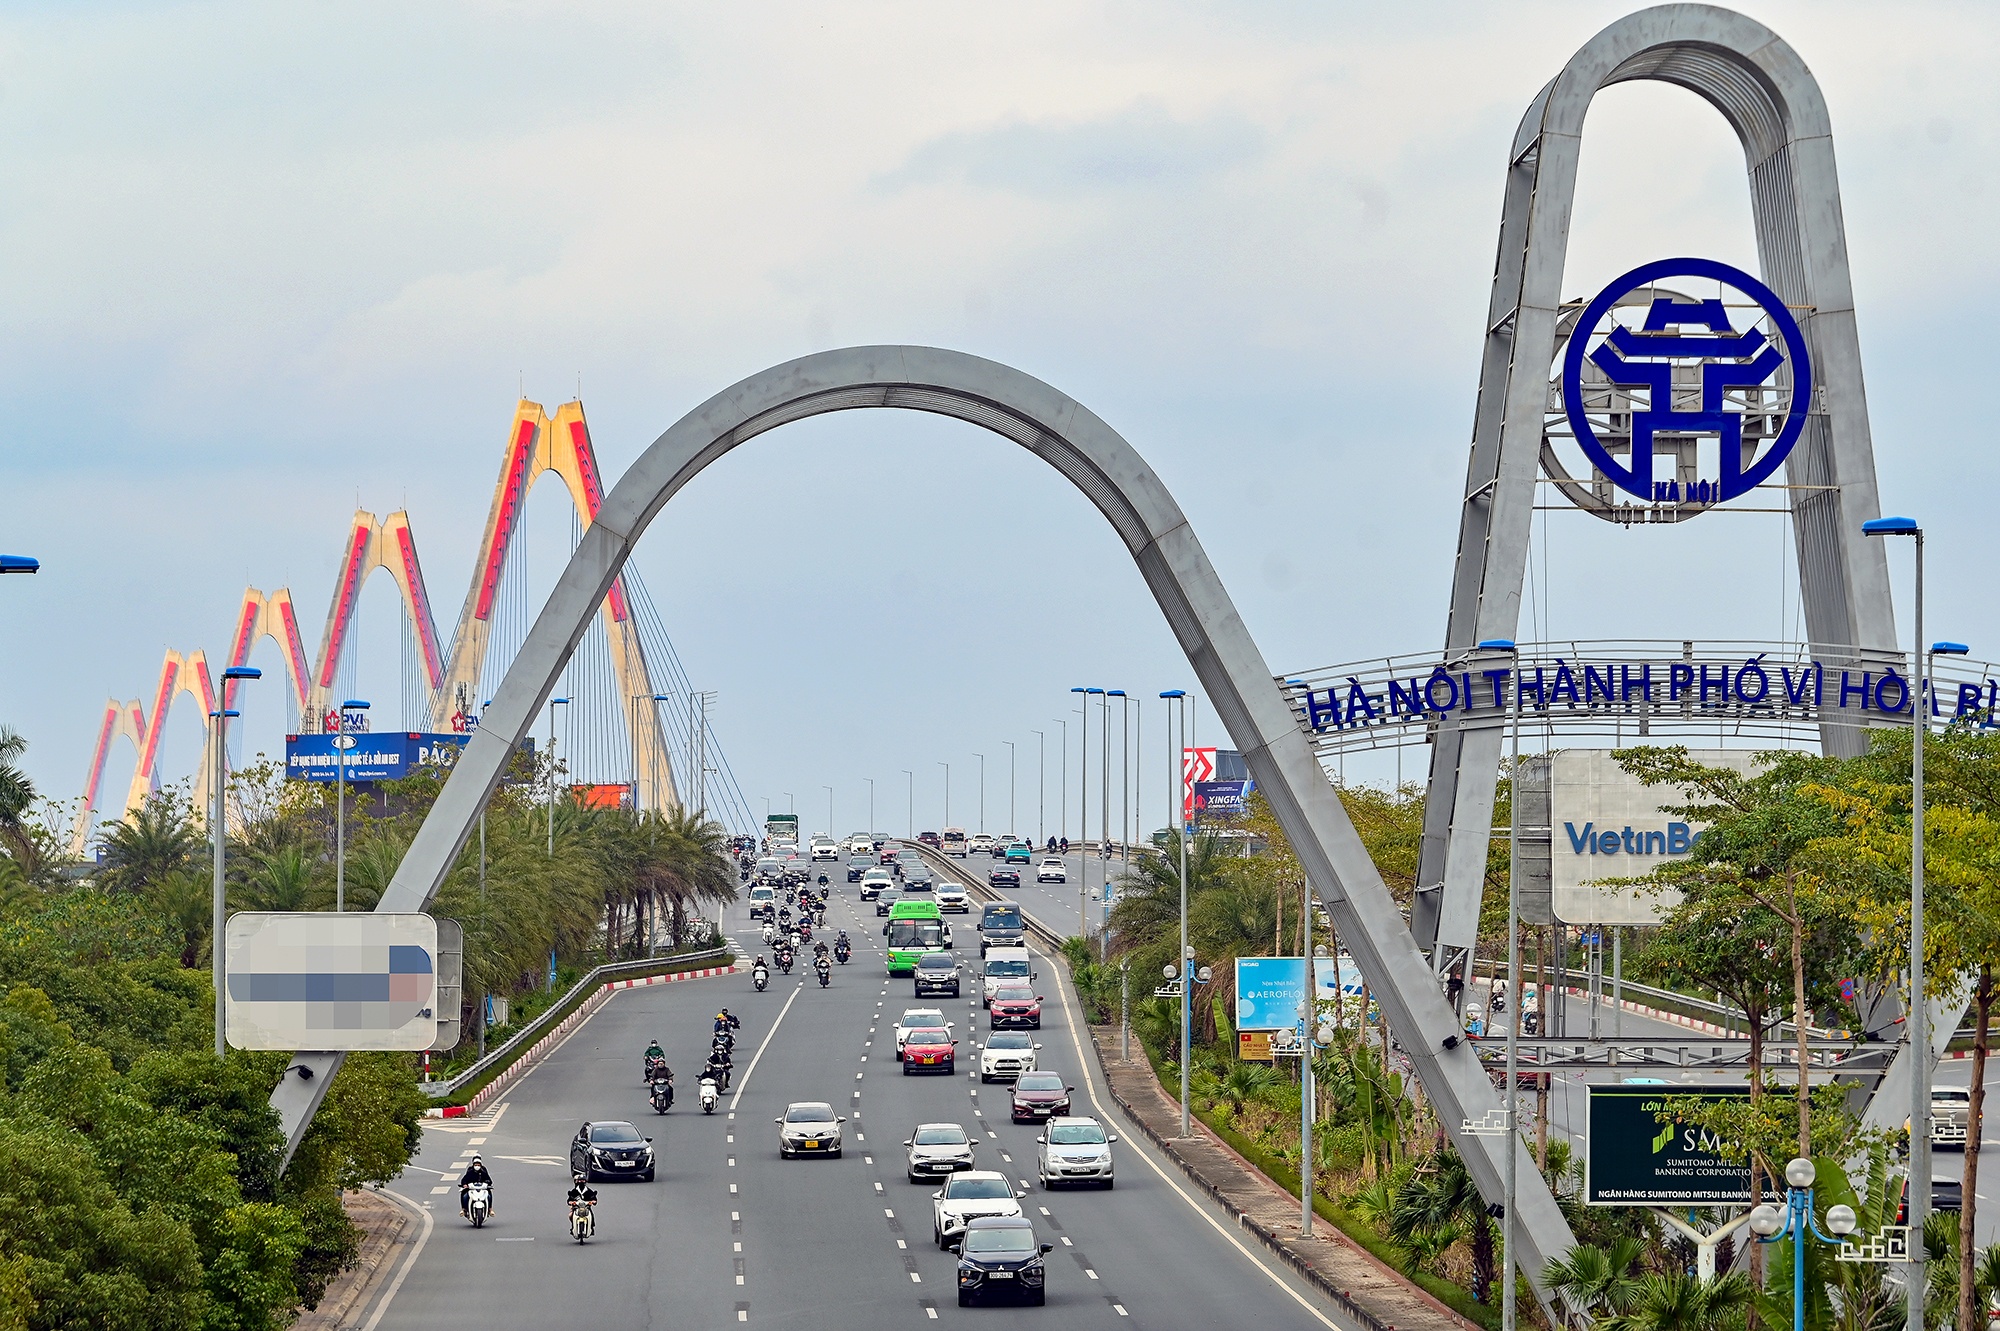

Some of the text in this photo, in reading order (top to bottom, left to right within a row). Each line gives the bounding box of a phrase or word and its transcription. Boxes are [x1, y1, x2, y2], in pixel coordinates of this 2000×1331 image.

[1654, 479, 1718, 506] HÀ NỘI
[1307, 677, 1376, 729] HÀ
[1388, 667, 1473, 721] NỘI
[1482, 658, 1651, 708] THÀNH
[1670, 654, 1769, 703] PHỐ
[1781, 660, 1823, 706] VÌ
[1839, 667, 1941, 717] HÒA
[1641, 1101, 1660, 1112] LỚN
[1666, 1159, 1714, 1167] SUMITOMO
[1655, 1168, 1752, 1176] BANKING CORPORATIO
[1598, 1188, 1622, 1198] NGÂN
[1623, 1188, 1647, 1198] HÀNG
[1648, 1190, 1692, 1198] SUMITOMO
[1722, 1191, 1752, 1199] BANKIN
